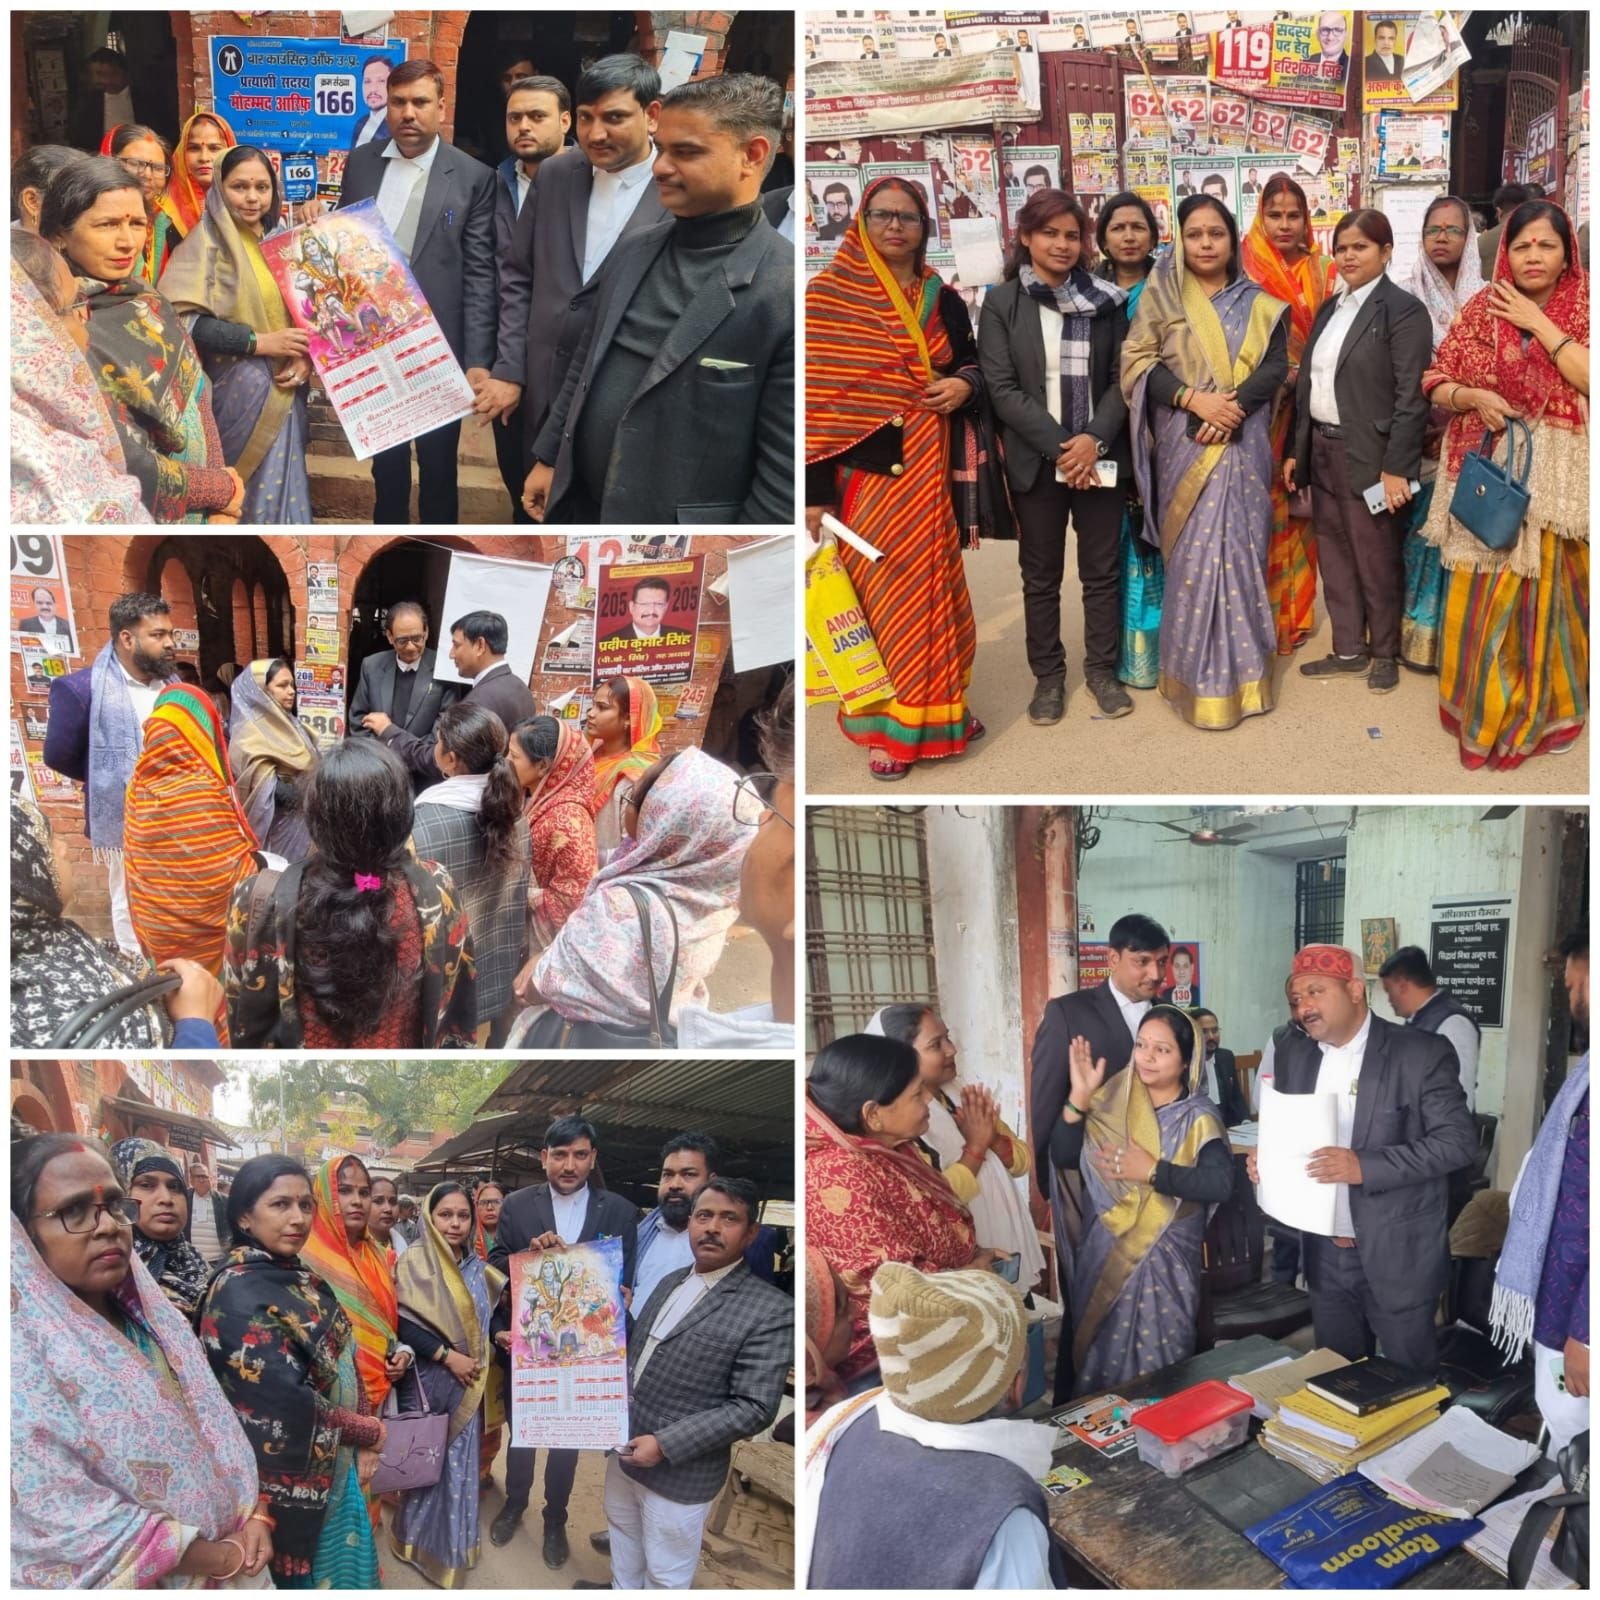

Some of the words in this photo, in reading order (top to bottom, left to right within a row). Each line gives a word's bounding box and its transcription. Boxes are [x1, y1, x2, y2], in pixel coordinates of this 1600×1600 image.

[1276, 24, 1313, 39] सदस्य
[1218, 26, 1271, 70] 119
[1276, 40, 1292, 53] पद
[1321, 60, 1344, 79] सिंह
[240, 73, 276, 89] प्रत्याशी
[281, 77, 311, 89] सदस्य
[231, 91, 273, 111] मोहम्मद
[316, 90, 354, 115] 166
[1130, 93, 1165, 117] 62
[1171, 99, 1206, 122] 62
[1099, 118, 1114, 126] 100
[1212, 102, 1246, 127] 62
[1252, 110, 1285, 138] 62
[1291, 128, 1325, 156] 62
[1343, 142, 1358, 151] 100
[1523, 115, 1556, 160] 330
[959, 148, 992, 172] 62
[290, 167, 311, 179] 166
[600, 591, 628, 618] 205
[671, 586, 700, 612] 205
[599, 636, 629, 652] प्रदीप
[630, 636, 665, 653] कुमार
[665, 631, 693, 647] सिंह
[43, 659, 65, 676] 18
[680, 687, 705, 704] 245
[33, 768, 54, 788] 119
[1173, 989, 1190, 1001] 130
[1319, 1512, 1455, 1574] Handloom
[1375, 1533, 1441, 1569] Ram
